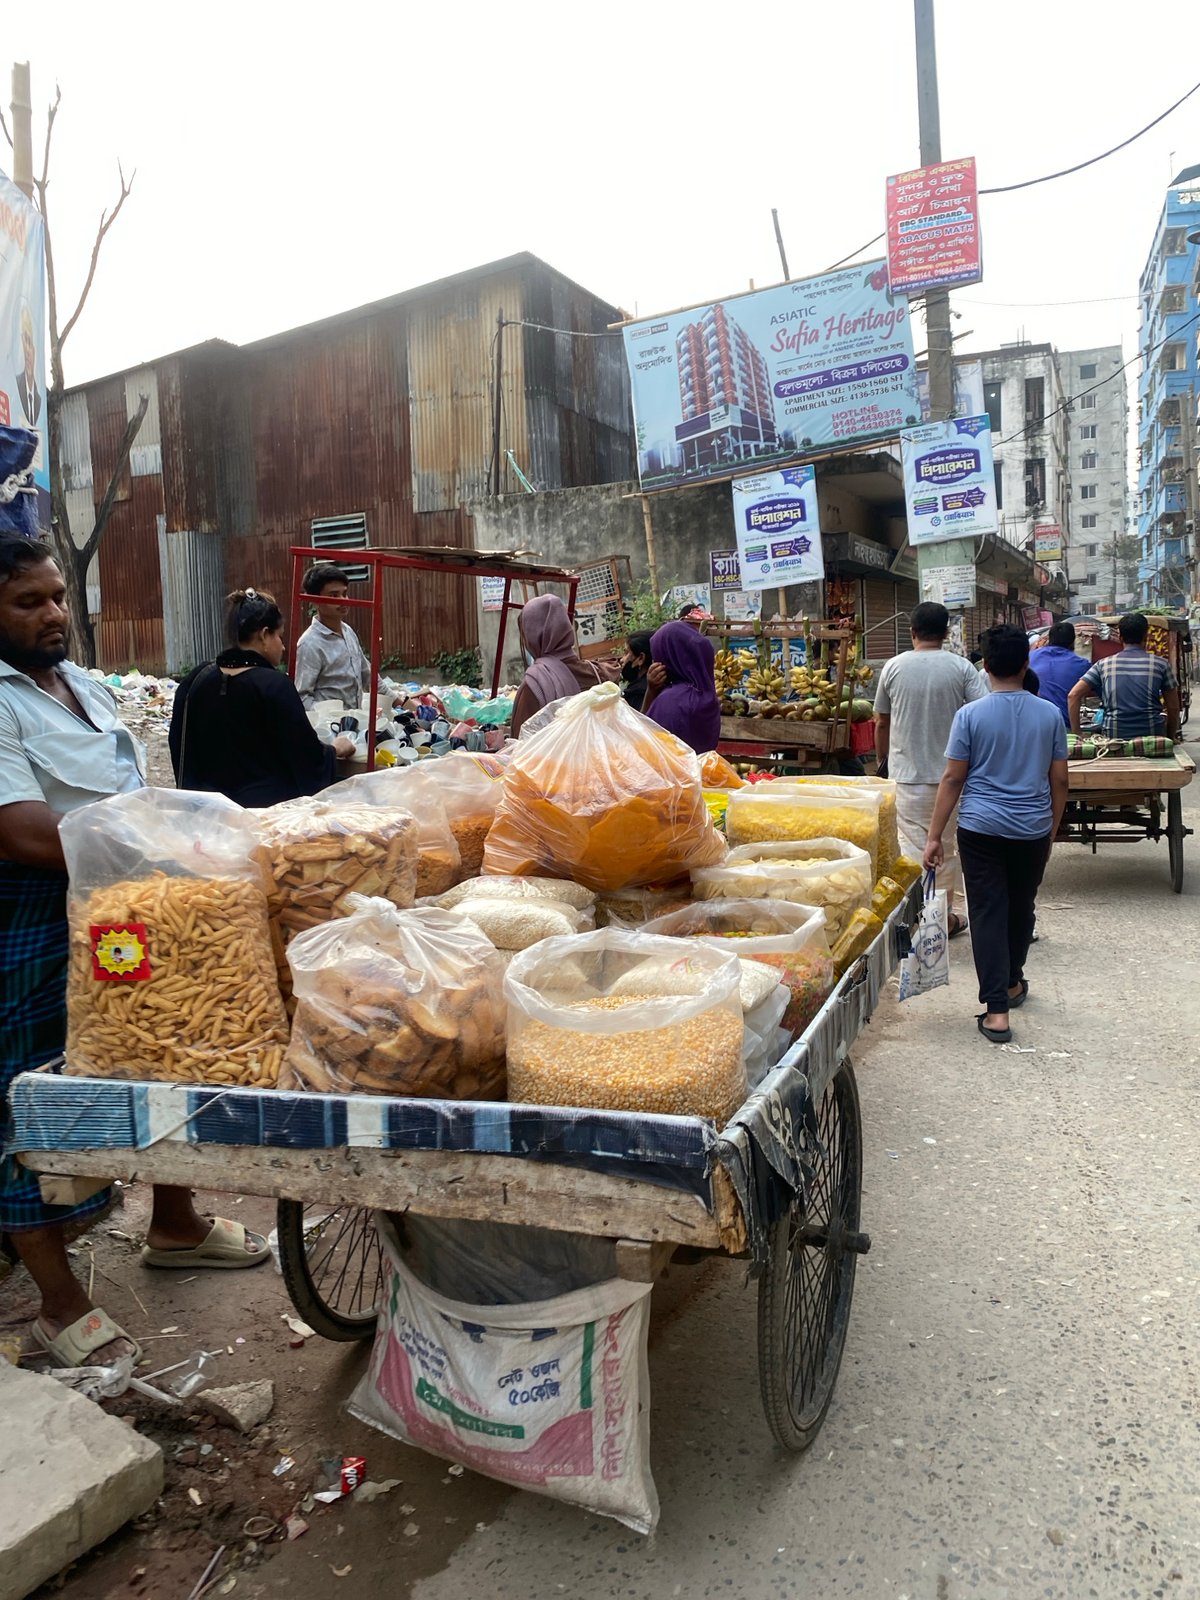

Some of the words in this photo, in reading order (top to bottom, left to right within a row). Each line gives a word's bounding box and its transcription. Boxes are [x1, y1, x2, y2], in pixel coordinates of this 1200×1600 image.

[896, 181, 924, 195] সুন্দর
[928, 178, 938, 186] ও
[940, 173, 966, 185] দ্রুত
[896, 190, 931, 204] হাতের
[935, 184, 962, 196] লেখা
[899, 220, 916, 228] BBC
[918, 211, 963, 224] STANDARD
[900, 222, 934, 233] SPOKEN
[936, 214, 973, 226] ENGLISH
[898, 231, 942, 245] ABACUS
[944, 224, 974, 236] MATH
[770, 305, 817, 326] ASIATIC
[631, 328, 651, 338] MEMBER
[770, 320, 819, 354] Sufia
[823, 307, 905, 340] Heritage
[638, 346, 666, 358] রাজউক
[635, 355, 673, 371] অনুমোদিত
[831, 369, 858, 382] বিক্রয়
[860, 357, 904, 374] চলিতেছে
[784, 391, 825, 406] APARTMENT
[827, 385, 846, 396] SIZE:
[847, 377, 889, 392] 1580-1860
[890, 374, 904, 383] SFT
[784, 401, 828, 415] COMMERCIAL
[831, 396, 849, 405] SIZE:
[850, 386, 890, 401] 4136-5736
[891, 383, 905, 392] SFT
[832, 404, 879, 420] HOTLINE
[920, 458, 976, 477] প্রিপারেশন
[750, 508, 802, 526] প্রিপারেশন
[714, 575, 741, 583] SSC-HSC-
[498, 1368, 523, 1388] নেট
[530, 1358, 560, 1378] ওজন
[509, 1378, 561, 1406] ৫০কেজি
